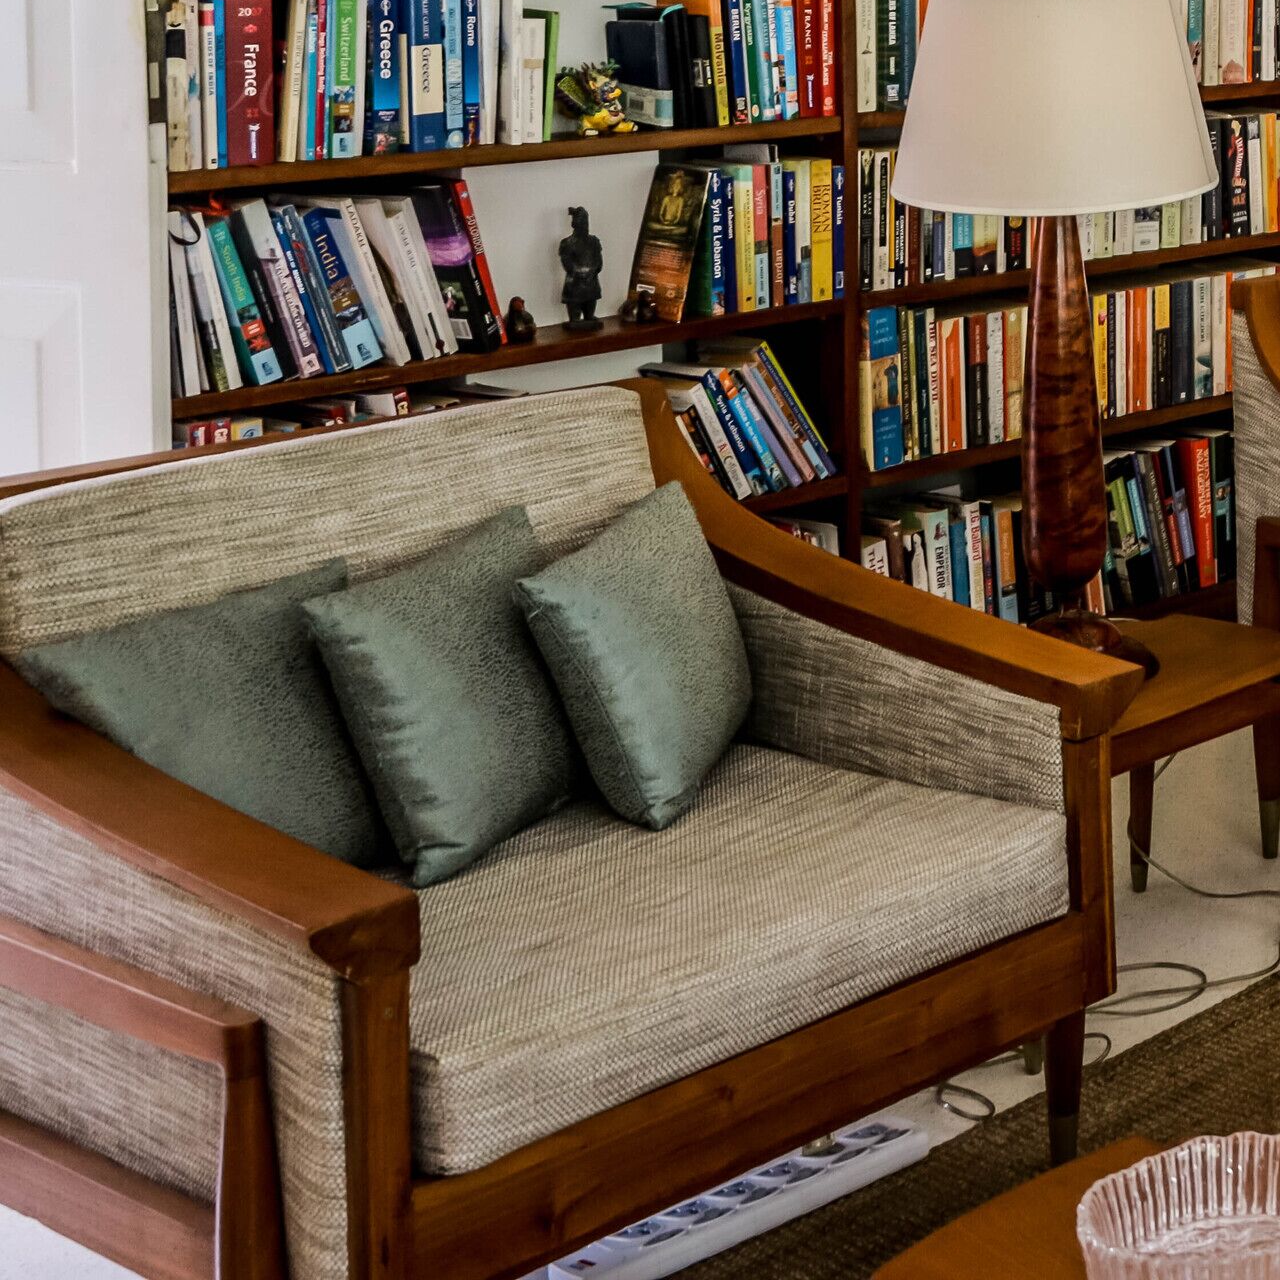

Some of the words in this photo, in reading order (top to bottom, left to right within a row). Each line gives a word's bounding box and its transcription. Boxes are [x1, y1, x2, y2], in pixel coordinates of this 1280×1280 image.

[466, 16, 476, 46] Rome
[731, 8, 740, 42] BERLIN
[804, 8, 812, 50] FRANCE
[244, 44, 258, 97] France
[340, 17, 352, 82] Switzerland
[379, 20, 394, 80] Greece
[422, 47, 431, 94] Greece
[711, 198, 722, 223] Syria
[758, 189, 766, 216] Syria
[813, 185, 822, 233] BRITAIN
[821, 184, 830, 232] ROMAN
[835, 196, 843, 225] Tunisia
[345, 204, 367, 248] LADAKH
[316, 233, 338, 280] India
[714, 236, 723, 278] Lebanon
[231, 276, 246, 302] India
[936, 546, 946, 590] EMPEROR
